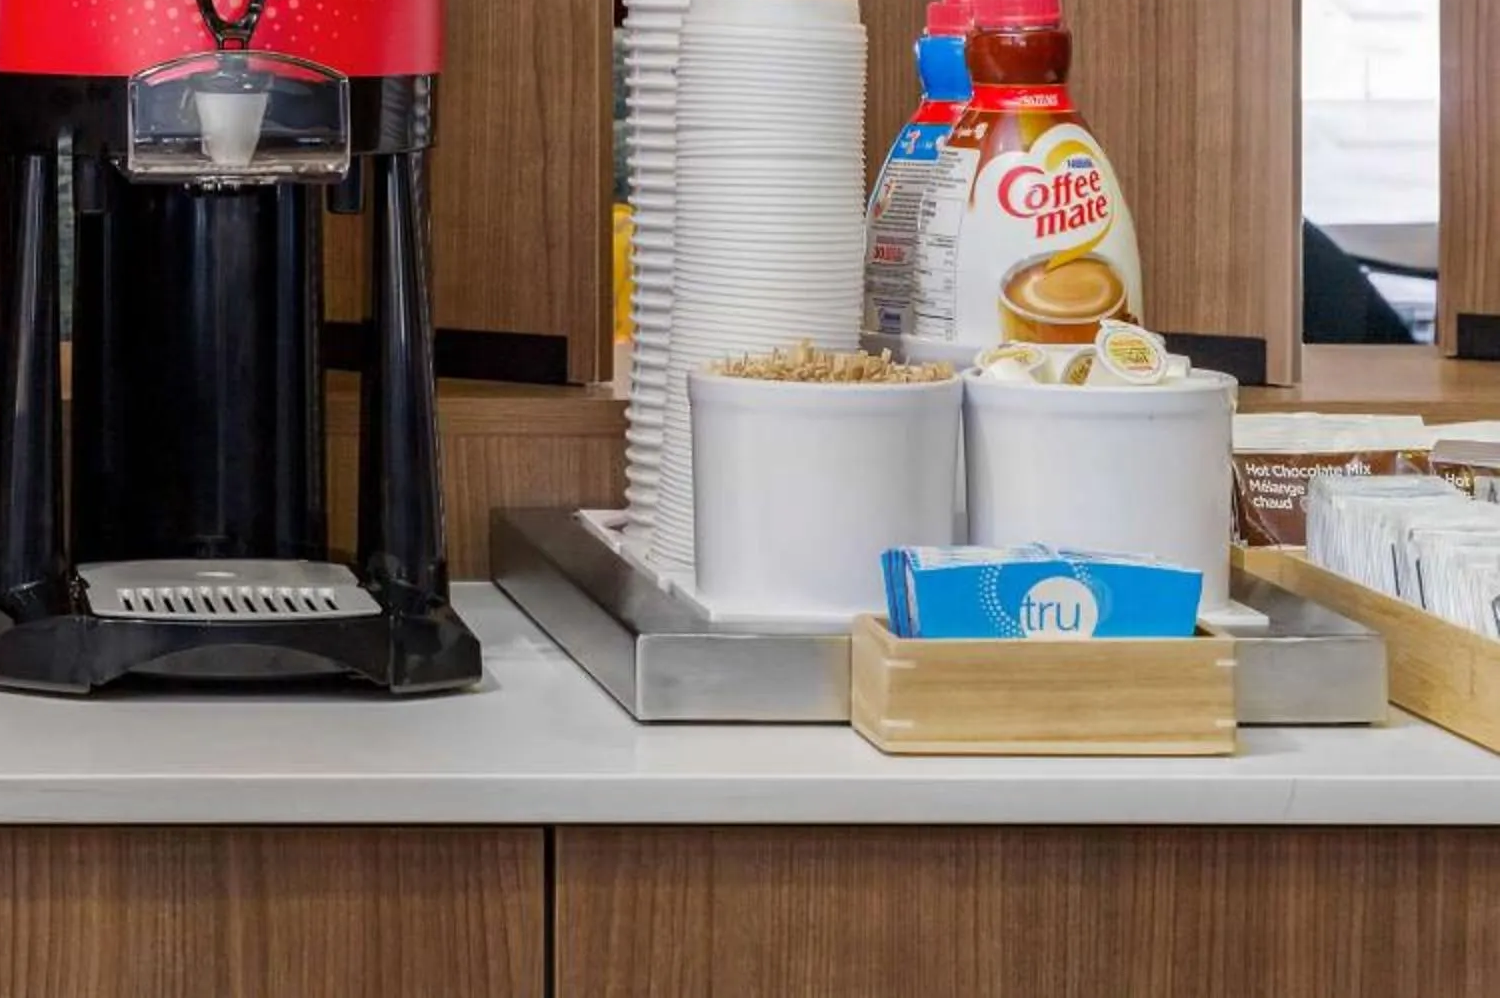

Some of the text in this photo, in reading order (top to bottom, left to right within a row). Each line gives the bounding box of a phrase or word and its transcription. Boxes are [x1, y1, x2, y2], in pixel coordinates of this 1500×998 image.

[997, 166, 1101, 218] Coffee
[1036, 194, 1108, 238] mate
[1245, 462, 1371, 478] Hot Chocolate Mix
[1250, 479, 1306, 496] Mélange
[1445, 473, 1470, 487] Hot
[1253, 495, 1293, 509] chaud
[1023, 594, 1081, 632] tru
